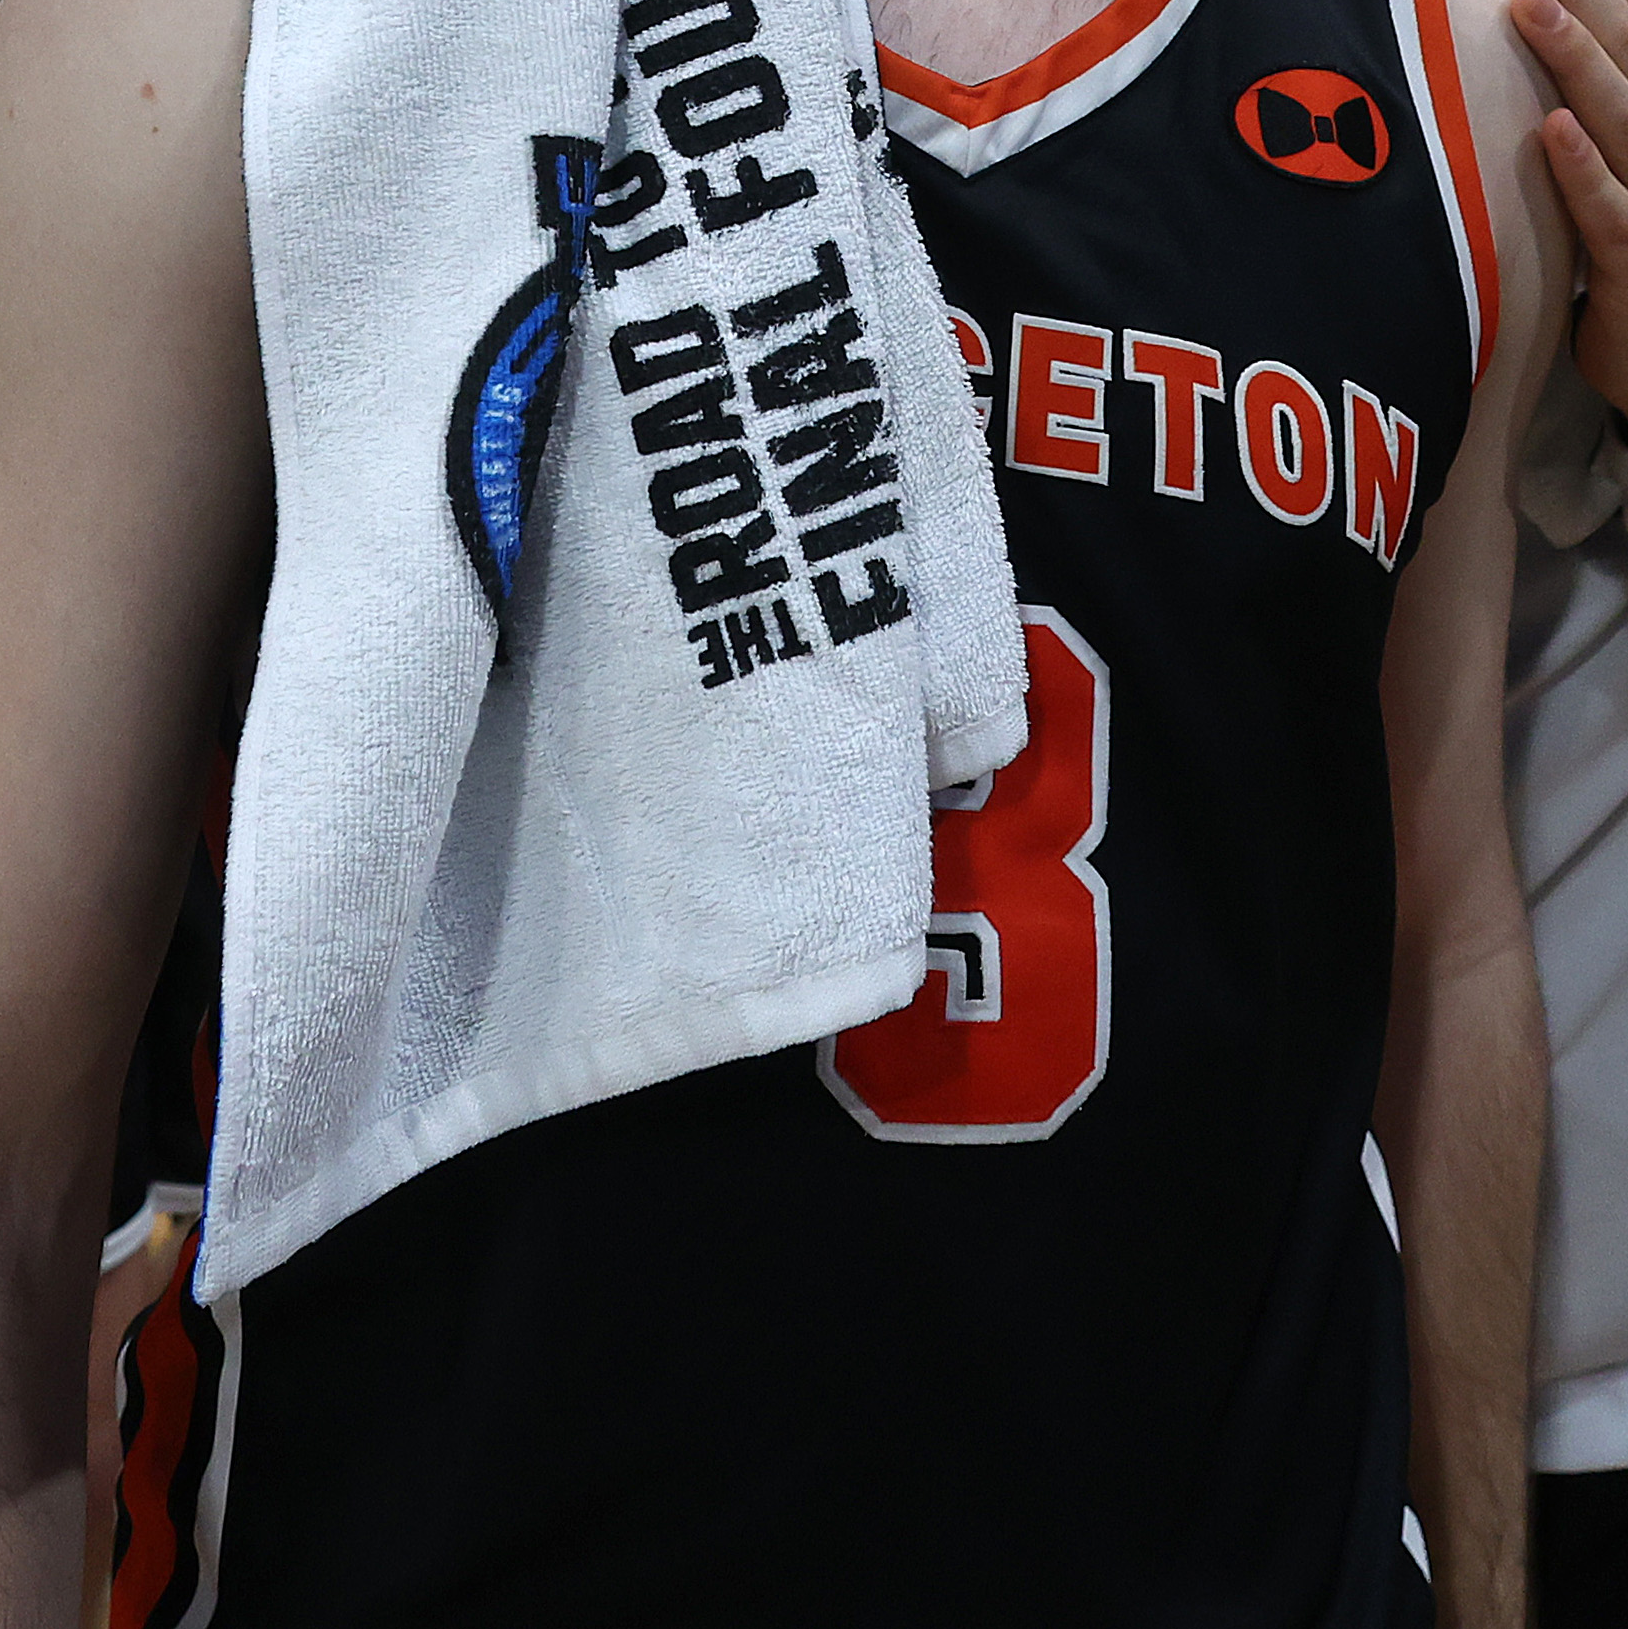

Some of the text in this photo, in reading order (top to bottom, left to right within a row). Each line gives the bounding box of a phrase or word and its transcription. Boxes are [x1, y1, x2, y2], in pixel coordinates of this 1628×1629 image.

[588, 149, 812, 688] THE ROAD TO
[730, 240, 912, 646] FINAL
